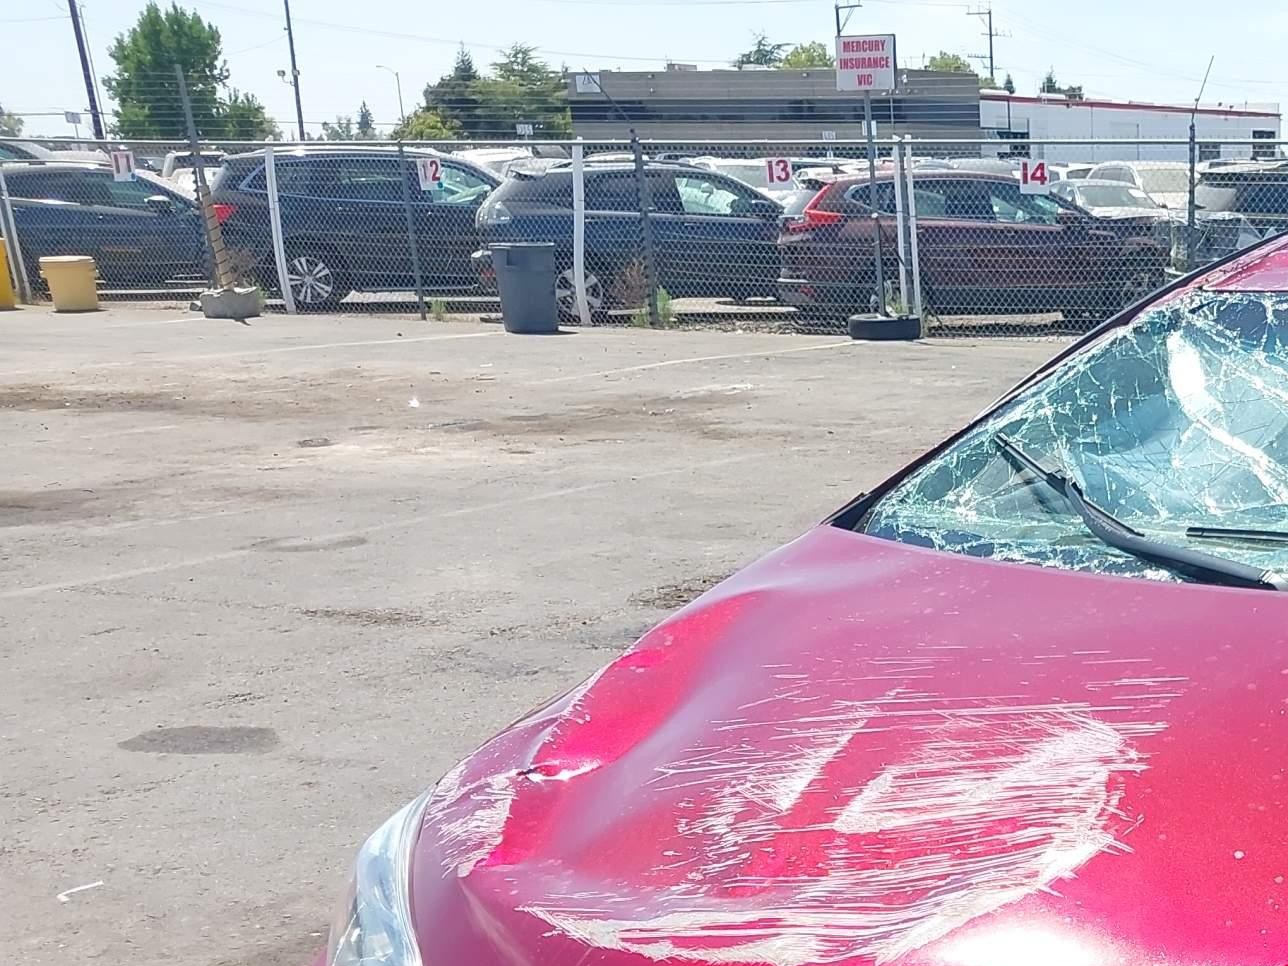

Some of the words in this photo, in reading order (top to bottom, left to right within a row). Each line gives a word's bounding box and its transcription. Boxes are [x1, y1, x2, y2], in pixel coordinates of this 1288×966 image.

[843, 40, 886, 53] MERCURY
[840, 57, 890, 70] INSURANCE
[857, 74, 873, 86] VIC
[768, 160, 790, 183] 13
[1022, 162, 1047, 185] 14
